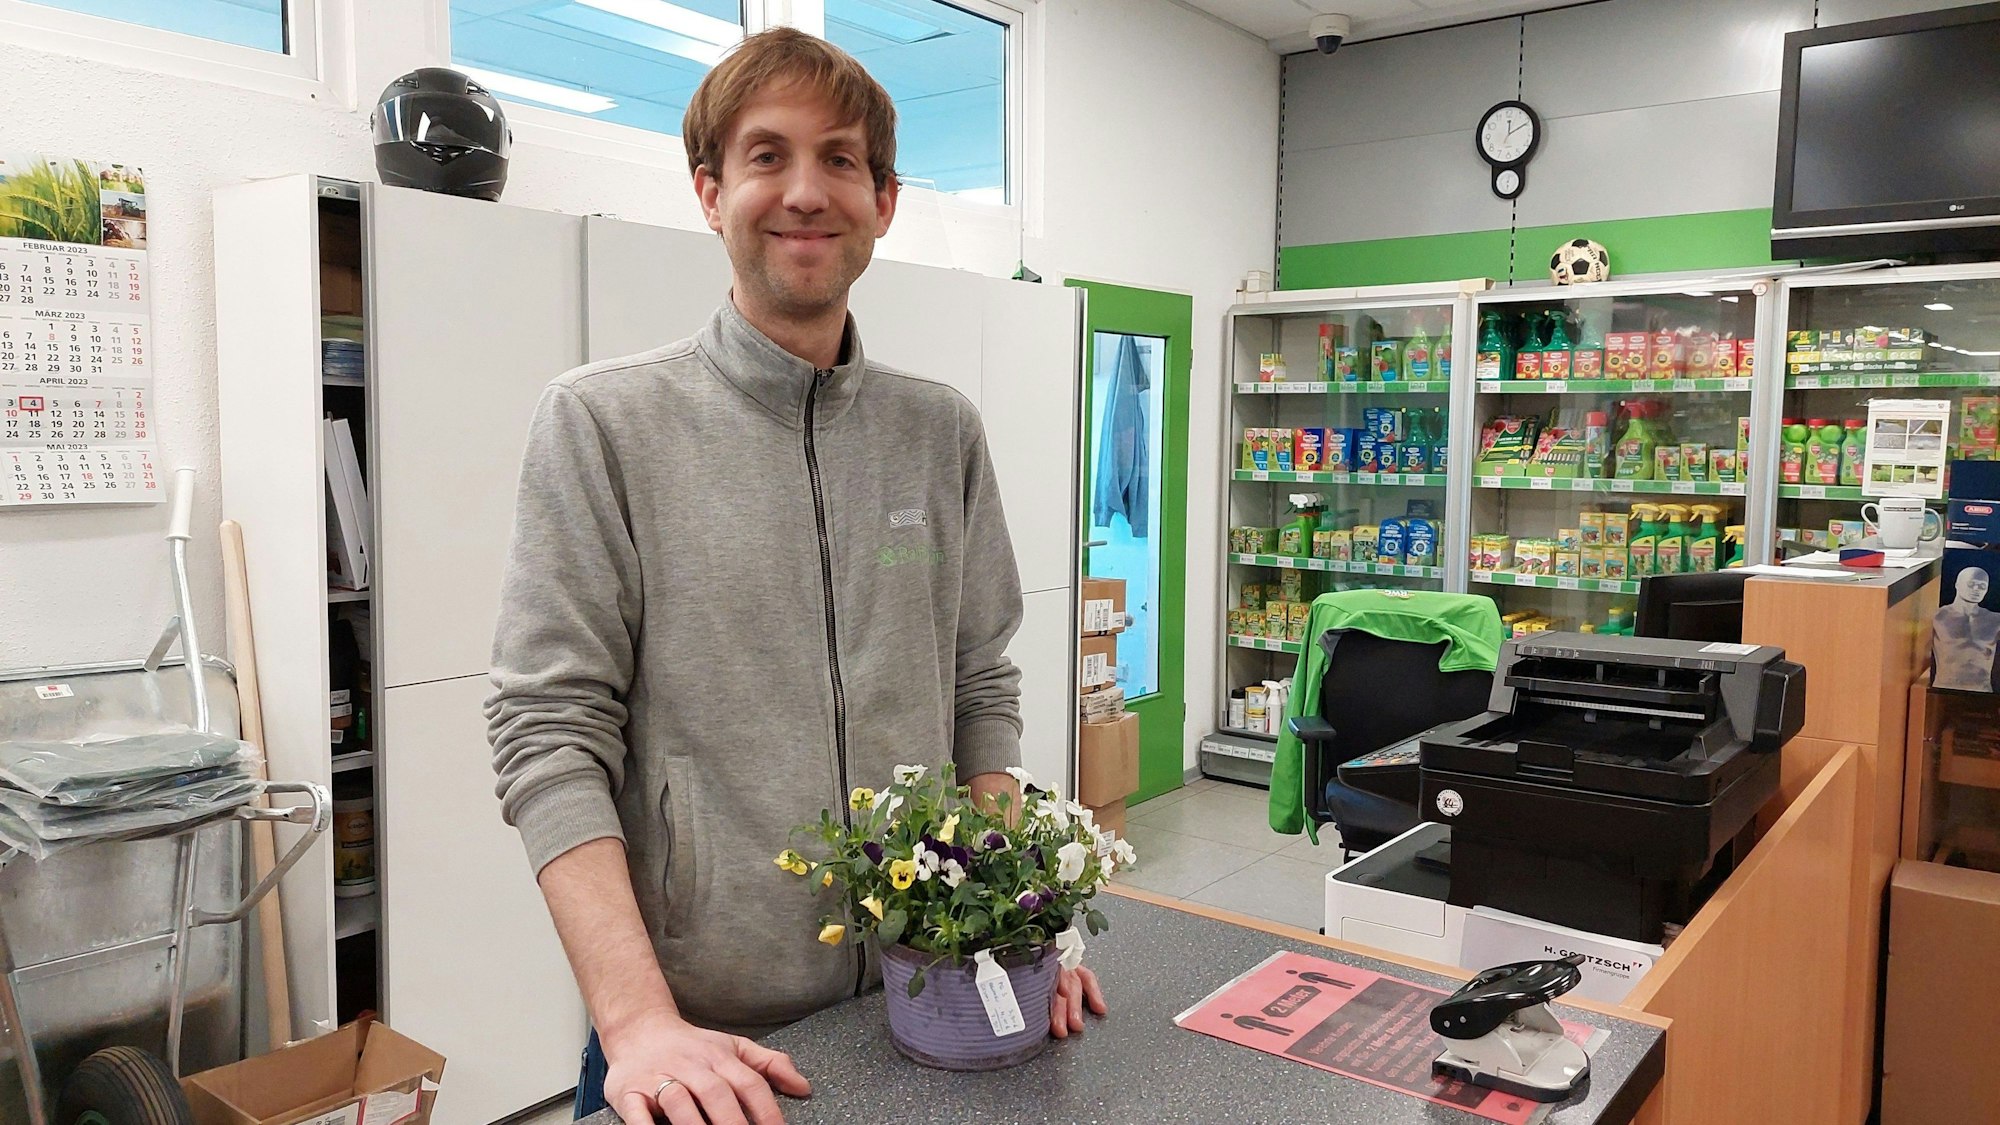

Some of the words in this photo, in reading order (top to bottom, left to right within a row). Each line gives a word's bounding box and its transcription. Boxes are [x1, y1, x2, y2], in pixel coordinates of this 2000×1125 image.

[23, 242, 65, 252] FEBRUAR
[67, 244, 88, 254] 2023
[129, 293, 140, 301] 26
[35, 310, 62, 319] MÄRZ
[1, 352, 14, 360] 20
[1544, 946, 1556, 954] H.
[1560, 949, 1631, 972] GOTZSCH
[1592, 966, 1630, 979] Firmengruppe
[1276, 988, 1314, 1008] Meter
